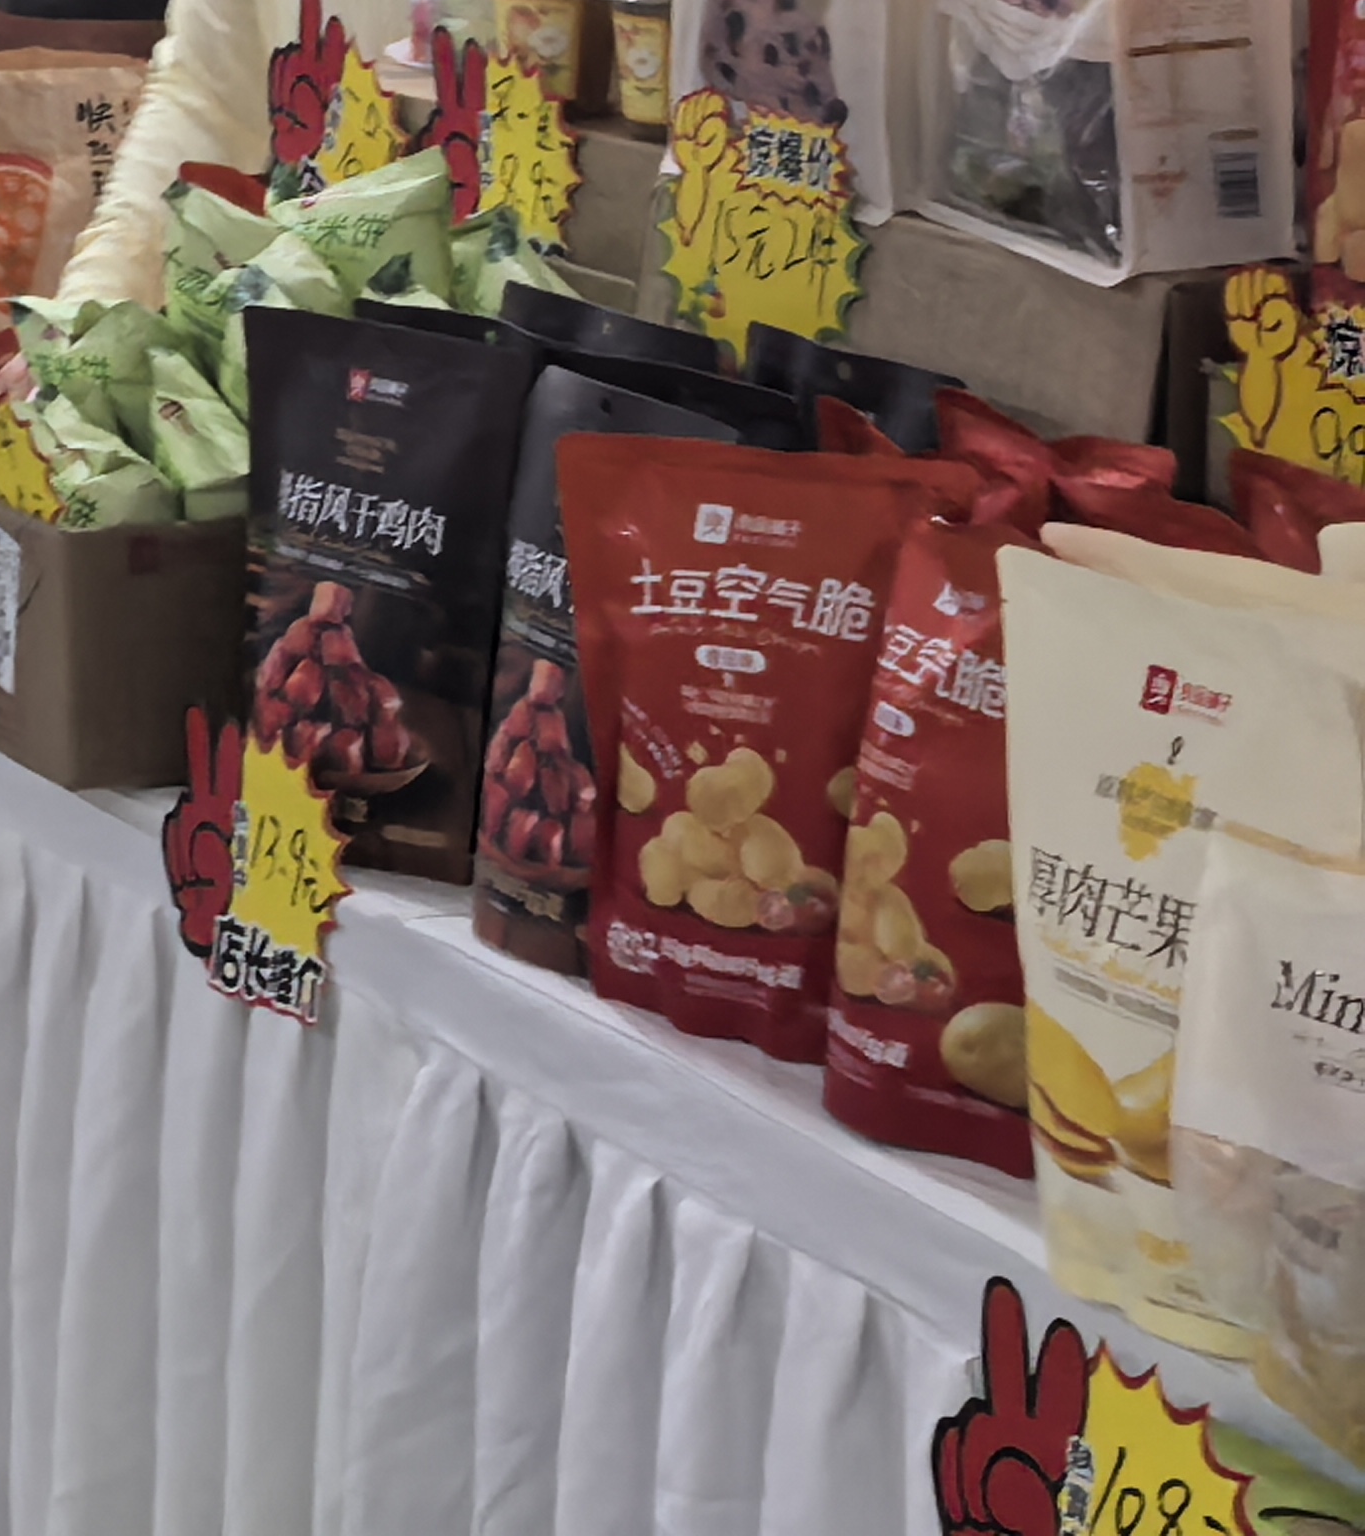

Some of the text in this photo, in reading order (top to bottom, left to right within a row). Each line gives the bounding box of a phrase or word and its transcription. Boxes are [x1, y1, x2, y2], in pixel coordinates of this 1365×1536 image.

[630, 558, 876, 642] 土豆空气脆
